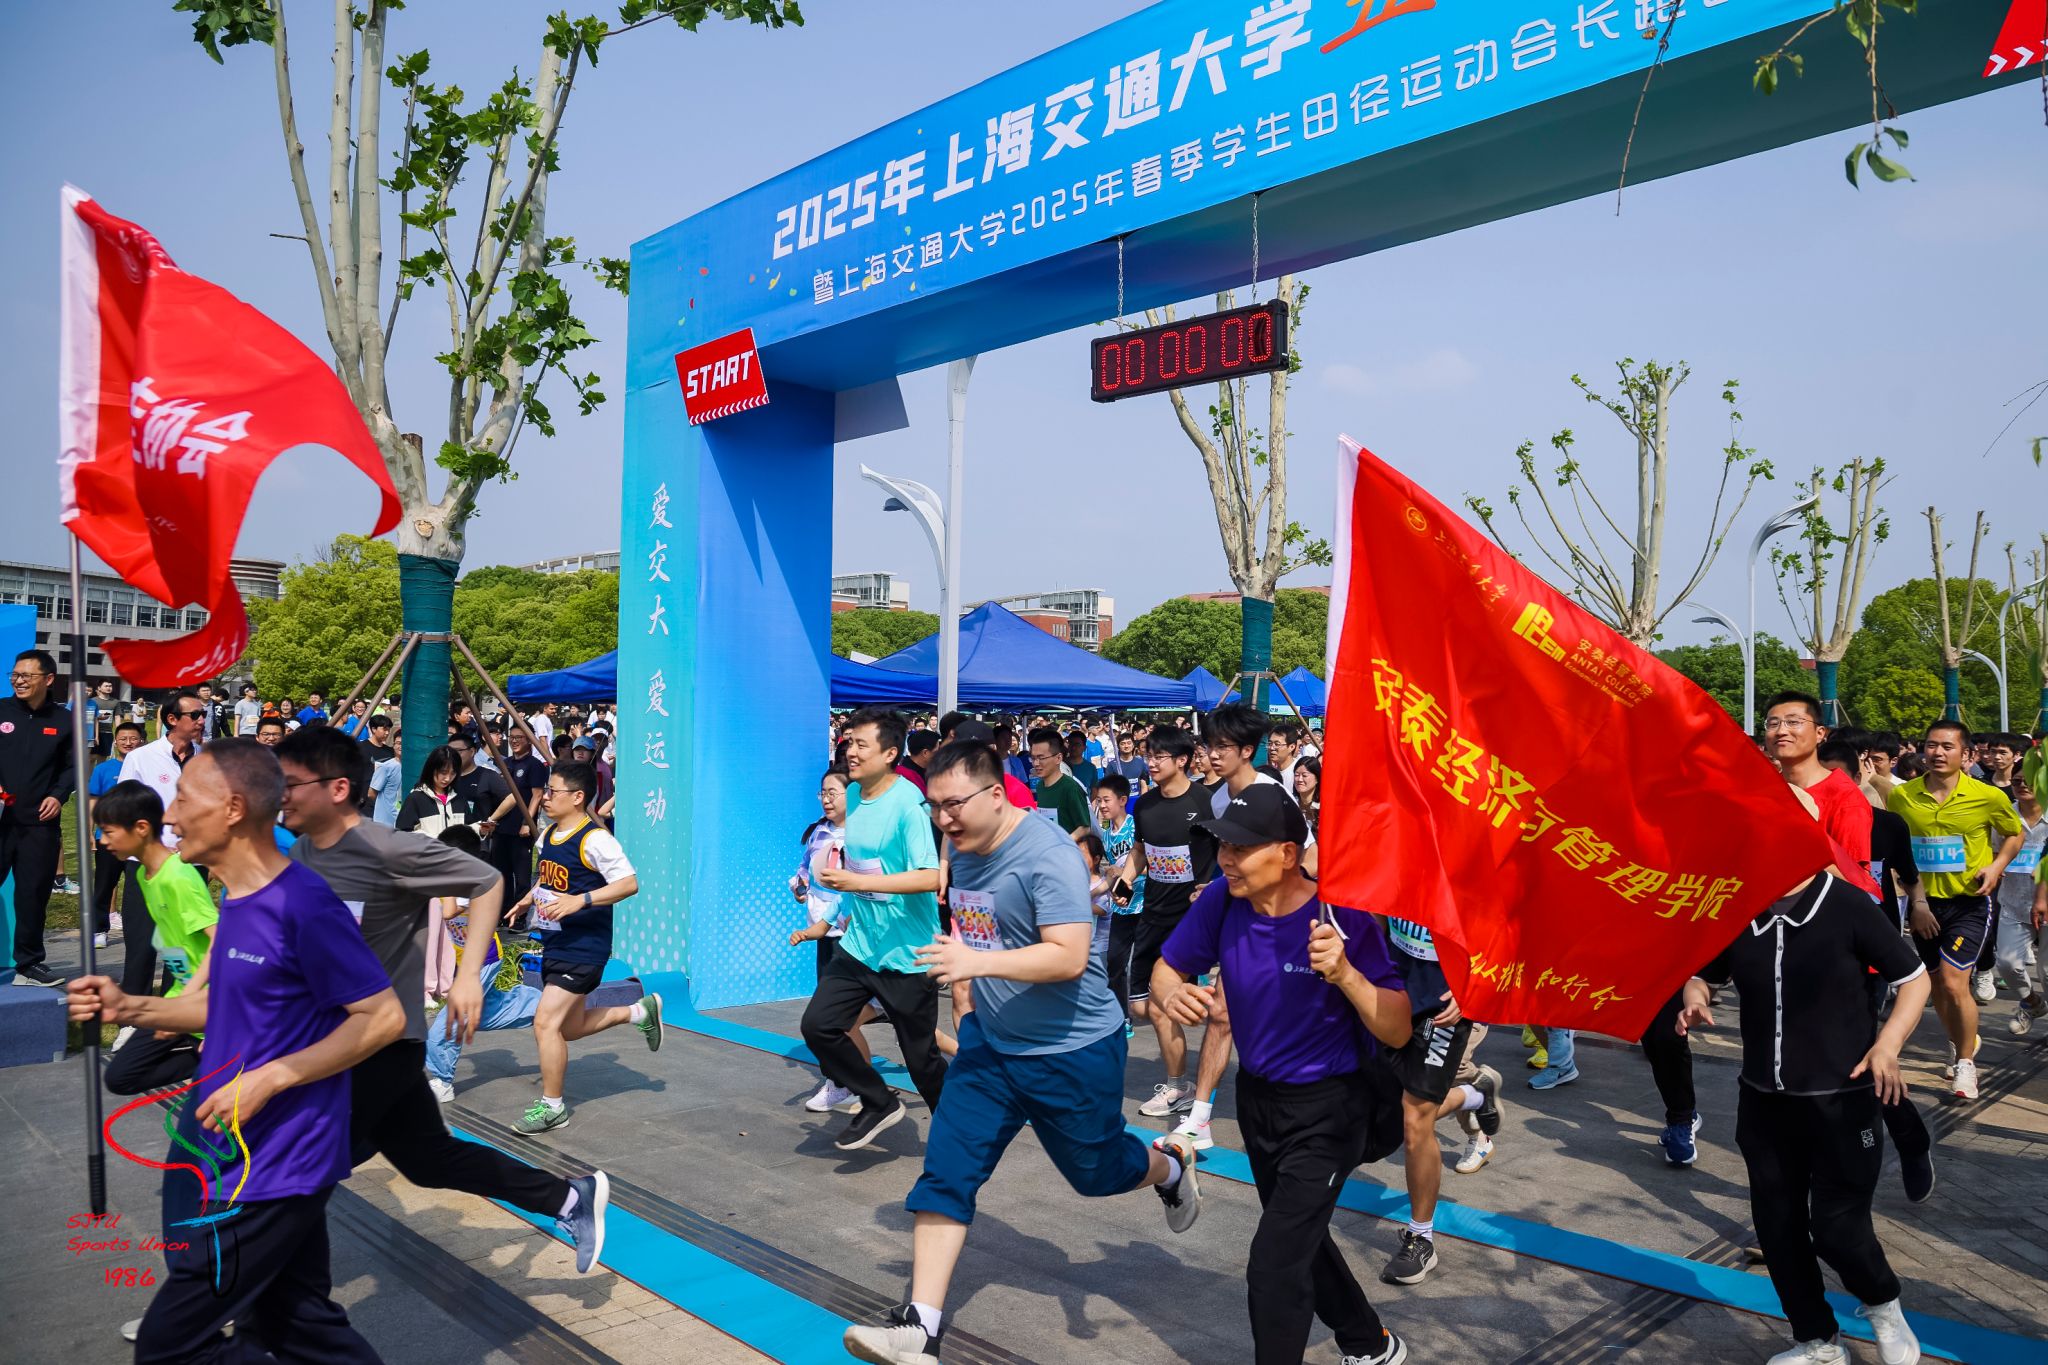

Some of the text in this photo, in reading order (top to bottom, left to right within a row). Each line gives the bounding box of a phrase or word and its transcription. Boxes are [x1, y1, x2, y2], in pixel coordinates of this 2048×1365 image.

[686, 349, 754, 399] START
[1102, 311, 1272, 391] 00 00 00
[1571, 653, 1643, 704] ANTAI COLLEGE
